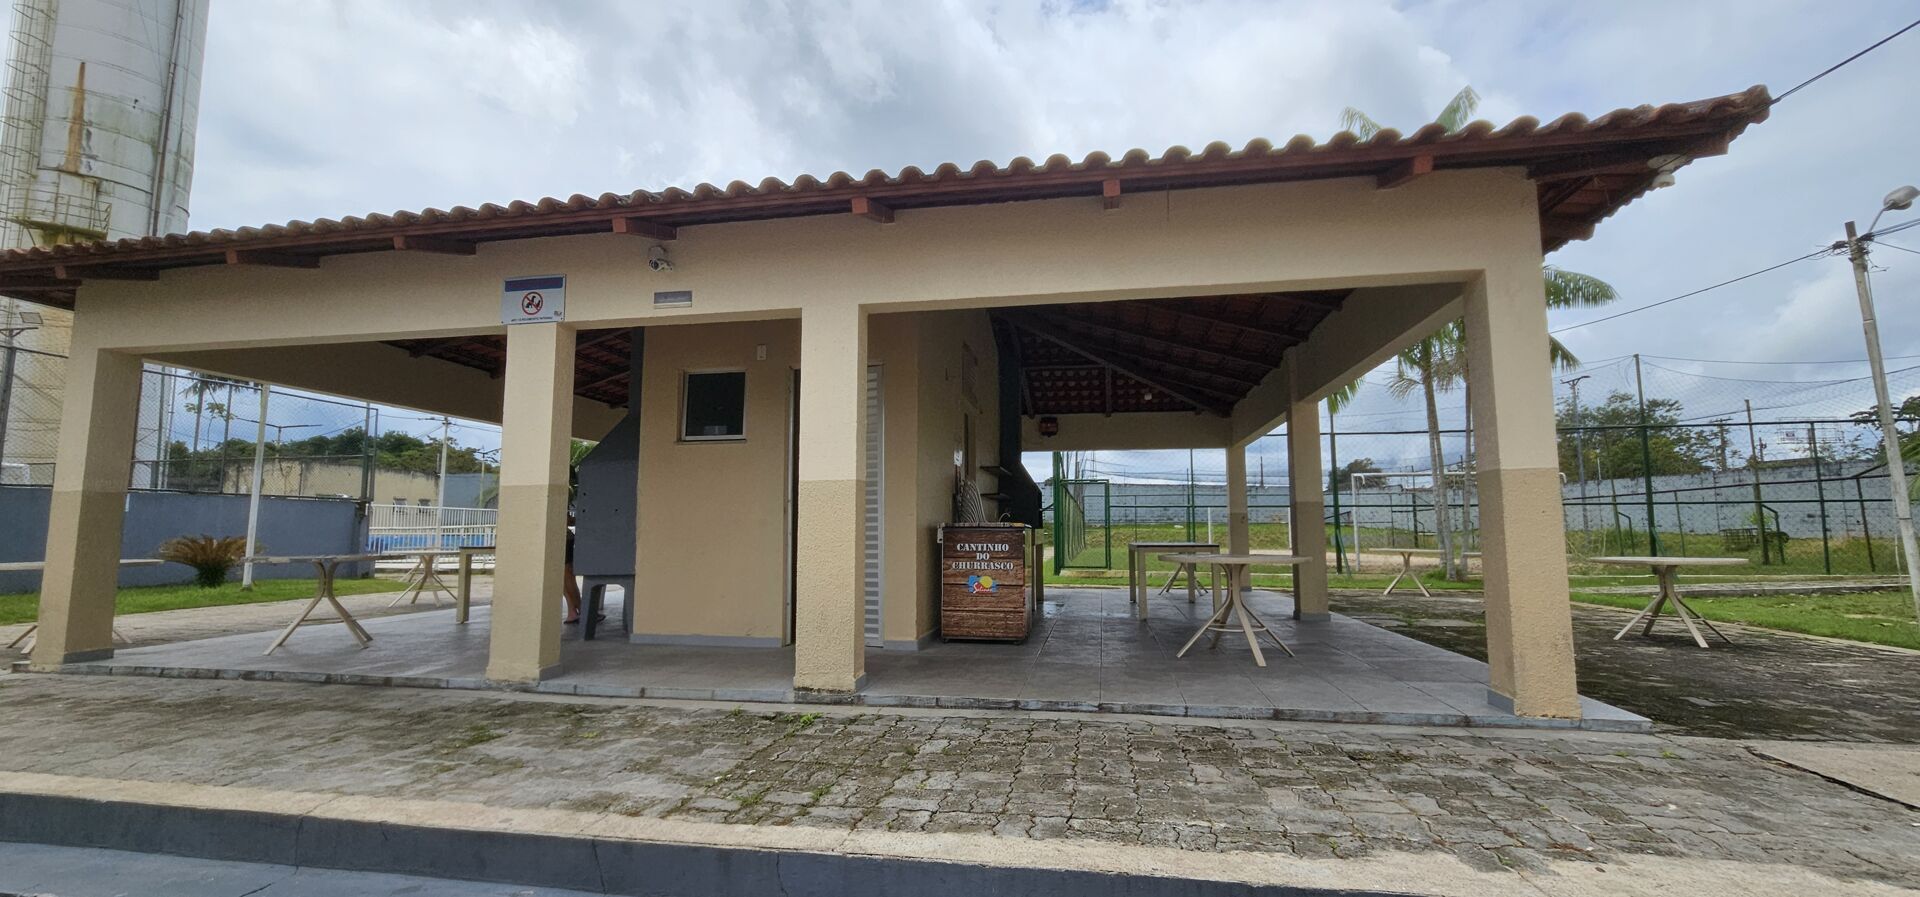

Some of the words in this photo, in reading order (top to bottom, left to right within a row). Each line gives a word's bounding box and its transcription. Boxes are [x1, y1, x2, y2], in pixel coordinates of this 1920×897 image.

[956, 543, 1009, 552] CANTINHO
[976, 552, 990, 560] DO
[952, 561, 1014, 570] CHURRASCO
